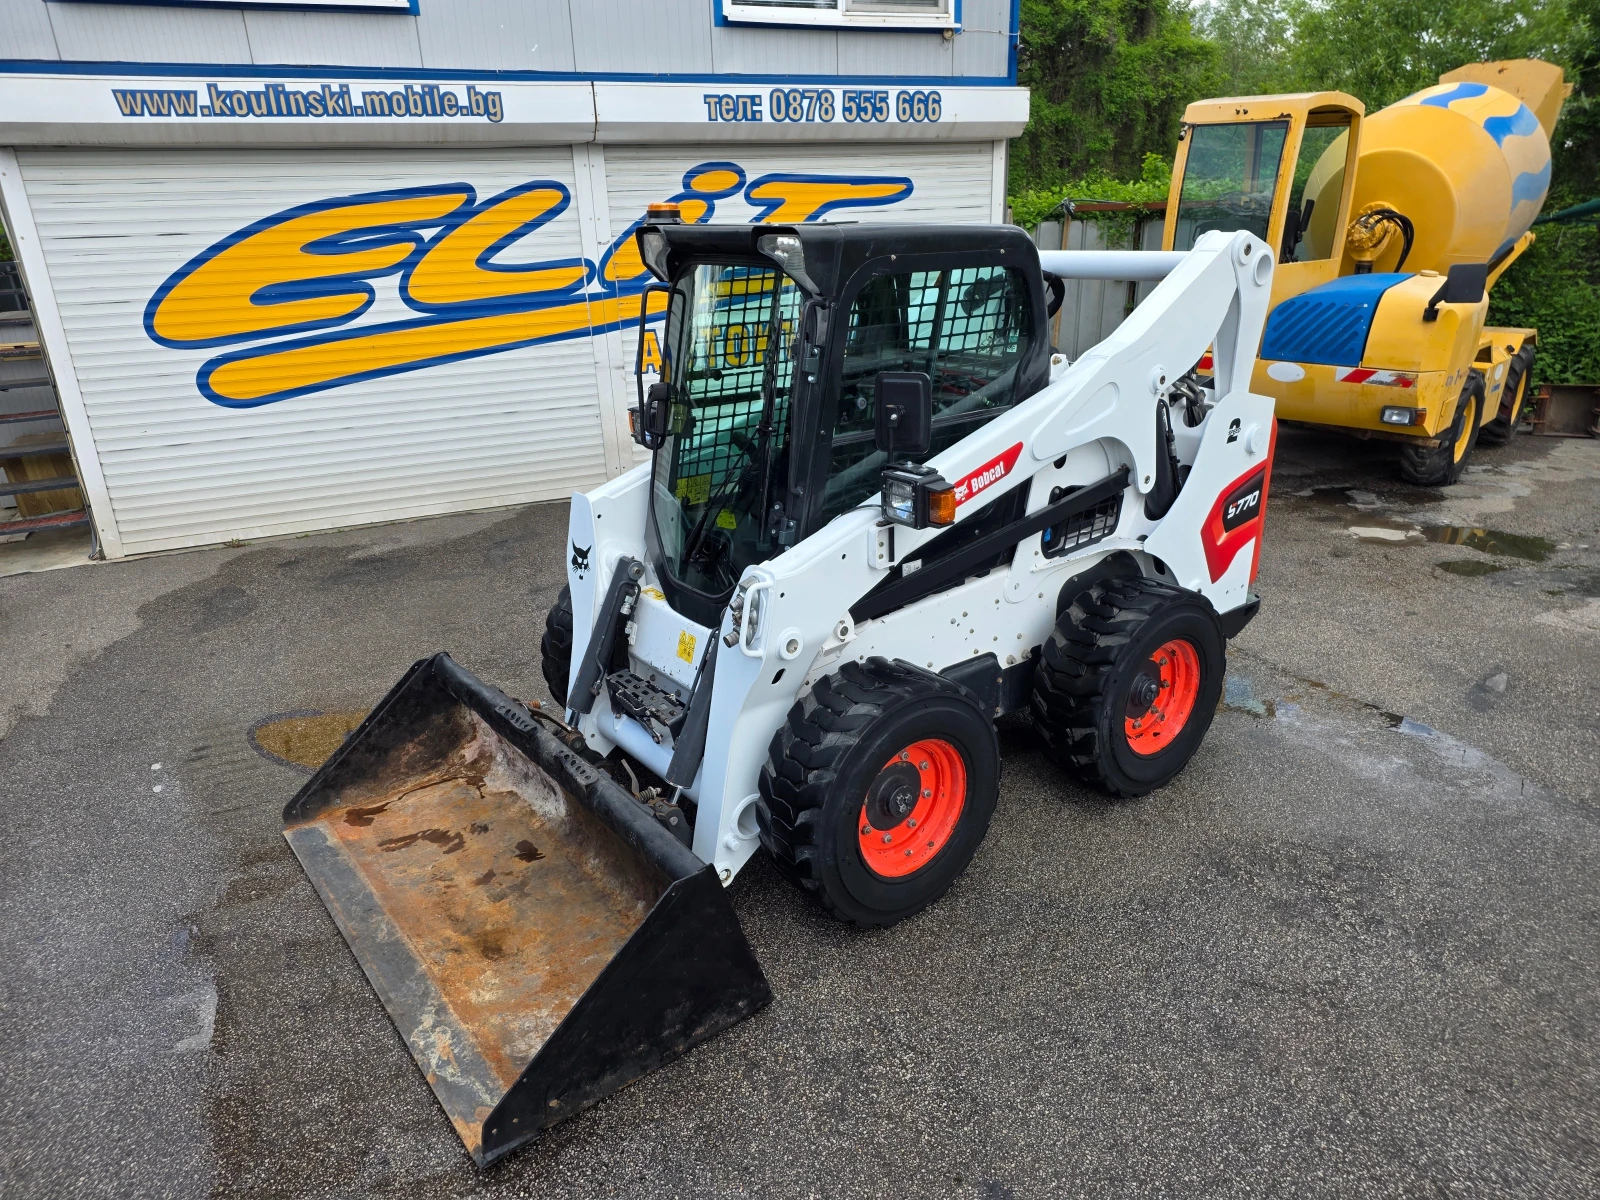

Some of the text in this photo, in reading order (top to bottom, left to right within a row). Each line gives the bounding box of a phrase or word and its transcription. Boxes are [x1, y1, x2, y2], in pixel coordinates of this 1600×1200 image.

[111, 83, 504, 123] www.koulinski.mobile.bg
[703, 88, 942, 122] тел: 0878 555 666
[970, 460, 1005, 493] Bobcat
[1227, 490, 1260, 519] S770
